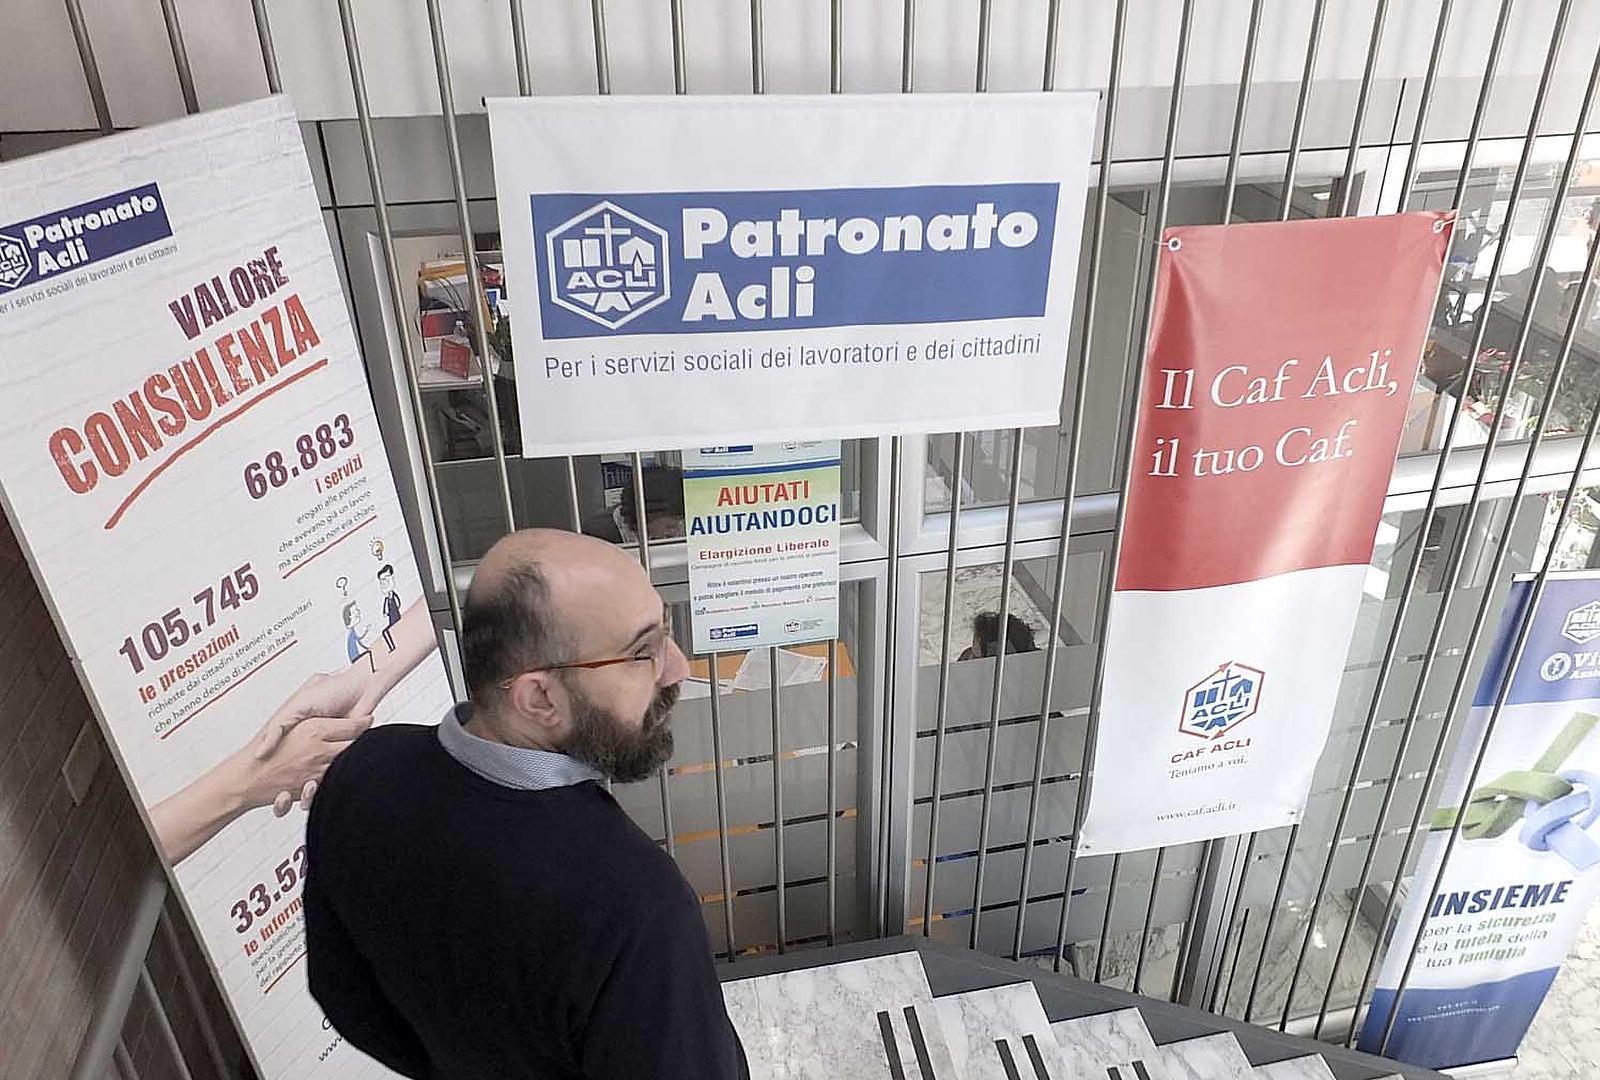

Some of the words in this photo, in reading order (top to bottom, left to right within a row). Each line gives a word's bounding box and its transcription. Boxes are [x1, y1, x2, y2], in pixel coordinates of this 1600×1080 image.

[24, 195, 158, 249] Patronato
[681, 202, 1039, 260] Patronato
[38, 238, 89, 275] Acli
[168, 246, 290, 341] VALORE
[566, 268, 656, 290] ACLI
[681, 265, 815, 323] Acli
[544, 356, 581, 379] Per
[591, 355, 597, 376] i
[604, 351, 676, 375] servizi
[683, 347, 753, 371] sociali
[761, 344, 792, 368] dei
[799, 342, 899, 366] lavoratori
[906, 343, 918, 360] e
[925, 339, 955, 360] dei
[961, 334, 1041, 358] cittadini
[49, 293, 321, 495] CONSULENZA
[1155, 368, 1195, 409] Il
[1211, 358, 1299, 408] Caf
[1301, 350, 1398, 397] Acli,
[244, 413, 355, 500] 68.883
[1148, 438, 1180, 477] il
[1193, 445, 1264, 477] tuo
[1276, 418, 1358, 467] Caf.
[325, 453, 363, 490] servizi
[717, 479, 810, 508] AIUTATI
[690, 503, 837, 536] AIUTANDOCI
[278, 558, 291, 571] ma
[279, 539, 293, 552] che
[699, 544, 772, 561] Elargizione
[777, 538, 830, 553] Liberale
[119, 562, 260, 675] 105.745
[138, 683, 157, 704] le
[159, 624, 241, 692] prestazioni
[148, 688, 185, 718] richieste
[186, 677, 200, 692] dai
[201, 653, 234, 681] cittadini
[235, 632, 266, 659] stranieri
[154, 716, 172, 733] che
[172, 695, 202, 720] hanno
[202, 674, 231, 699] deciso
[232, 665, 241, 679] di
[1191, 697, 1250, 721] ACLI
[1171, 747, 1206, 764] CAF
[1210, 737, 1251, 754] ACLI
[1430, 879, 1573, 918] INSIEME
[243, 940, 259, 957] le
[260, 897, 303, 942] inform
[1422, 926, 1453, 940] per
[1457, 923, 1472, 933] la
[1433, 941, 1448, 952] la
[1455, 932, 1503, 949] tutela
[1507, 929, 1548, 943] della
[1426, 957, 1452, 968] tua
